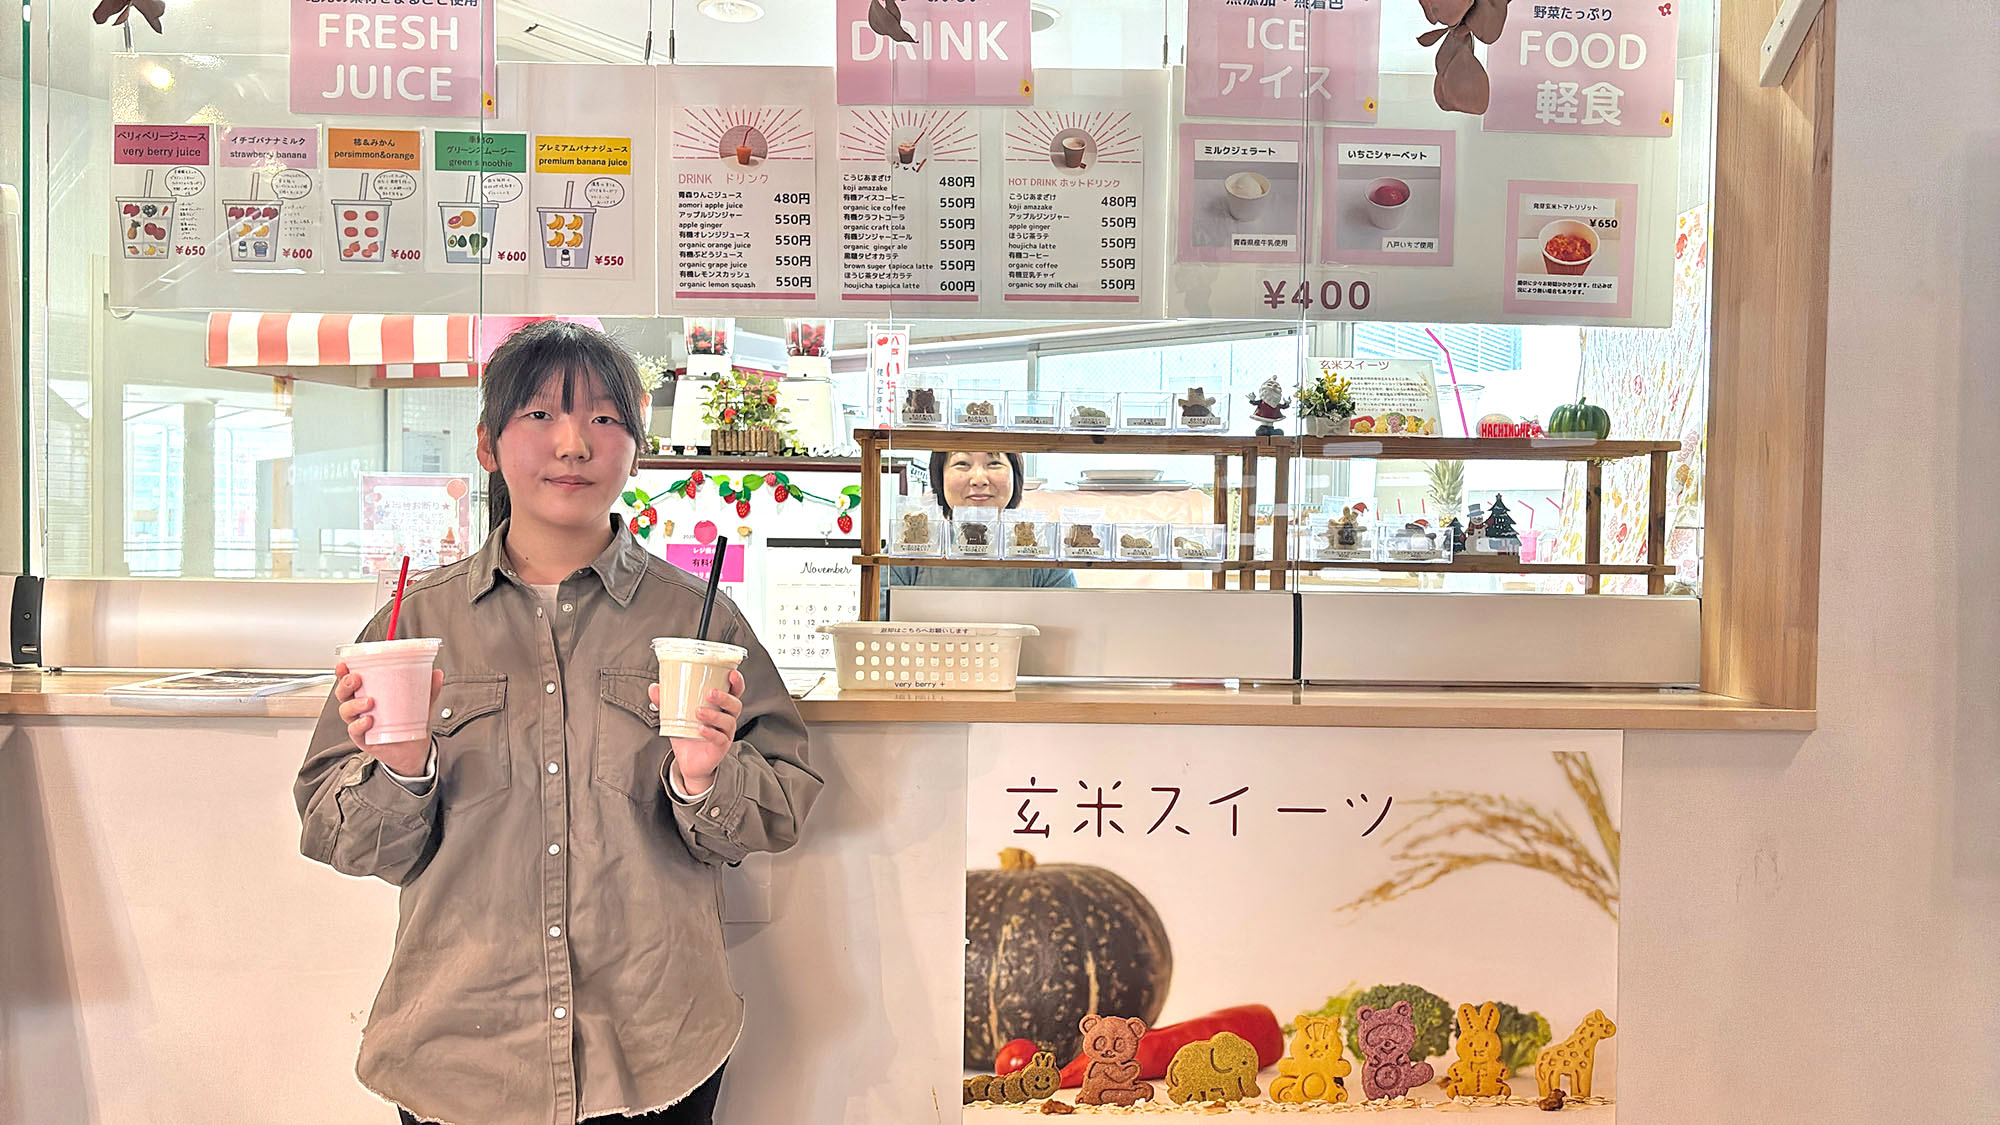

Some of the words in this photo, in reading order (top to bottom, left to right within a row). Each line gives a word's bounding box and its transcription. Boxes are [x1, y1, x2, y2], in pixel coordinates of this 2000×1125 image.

[1533, 6, 1612, 21] 野菜たっぷり
[319, 13, 458, 50] FRESH
[1247, 17, 1308, 51] ICE
[851, 20, 1008, 61] DRINK
[1520, 30, 1648, 70] FOOD
[322, 64, 453, 102] JUICE
[1220, 63, 1331, 100] アイス
[1535, 80, 1625, 126] 軽食
[231, 136, 306, 145] イチゴバナナミルク
[122, 147, 144, 158] very
[147, 147, 172, 157] berry
[175, 148, 201, 157] juice
[539, 143, 628, 153] プレミアムバナナジュース
[1204, 146, 1276, 156] ミルクジェラート
[276, 151, 307, 159] banana
[1347, 150, 1427, 160] いちごシャーベット
[539, 158, 574, 167] premium
[576, 158, 606, 166] banana
[608, 158, 627, 167] juice
[678, 173, 712, 184] DRINK
[726, 174, 768, 184] ドリンク
[939, 176, 975, 188] 480円
[1008, 178, 1027, 186] HOT
[1030, 178, 1057, 187] DRINK
[1060, 179, 1120, 188] ホットドリンク
[774, 193, 810, 204] 480円
[940, 197, 975, 209] 550円
[1101, 196, 1136, 208] 480円
[774, 214, 810, 225] 550円
[940, 219, 975, 230] 550円
[1101, 217, 1136, 228] 550円
[1590, 219, 1618, 228] ¥650
[775, 235, 811, 246] 550円
[940, 239, 975, 250] 550円
[1101, 238, 1136, 249] 550円
[1233, 238, 1288, 247] 青森県産牛乳使用
[176, 245, 206, 256] ¥650
[282, 248, 313, 259] ¥600
[391, 249, 421, 260] ¥600
[498, 251, 527, 262] ¥600
[595, 255, 624, 266] ¥550
[775, 256, 811, 267] 550円
[940, 260, 975, 271] 550円
[1101, 258, 1135, 269] 550円
[776, 276, 811, 288] 550円
[940, 281, 975, 292] 600円
[1100, 279, 1135, 290] 550円
[1263, 280, 1370, 310] ¥400
[1320, 360, 1389, 371] 玄米スイーツ
[800, 562, 852, 574] November
[1005, 776, 1394, 839] 玄米スイーツ
